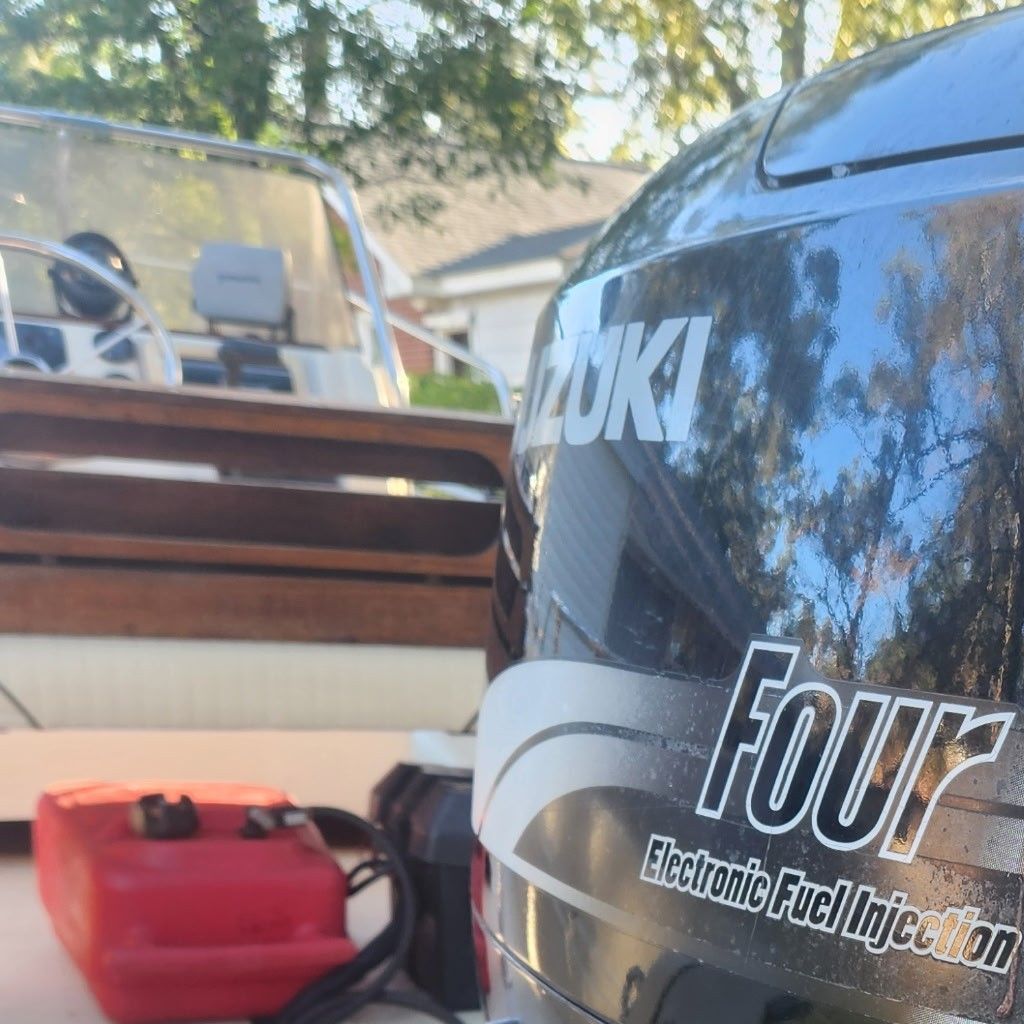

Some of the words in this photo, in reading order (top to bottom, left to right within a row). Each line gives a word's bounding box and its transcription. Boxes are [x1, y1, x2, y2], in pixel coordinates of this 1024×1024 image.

[696, 640, 1016, 863] Four
[640, 833, 771, 912] Electronic
[766, 868, 853, 933] Fuel
[841, 885, 1022, 974] Injection
